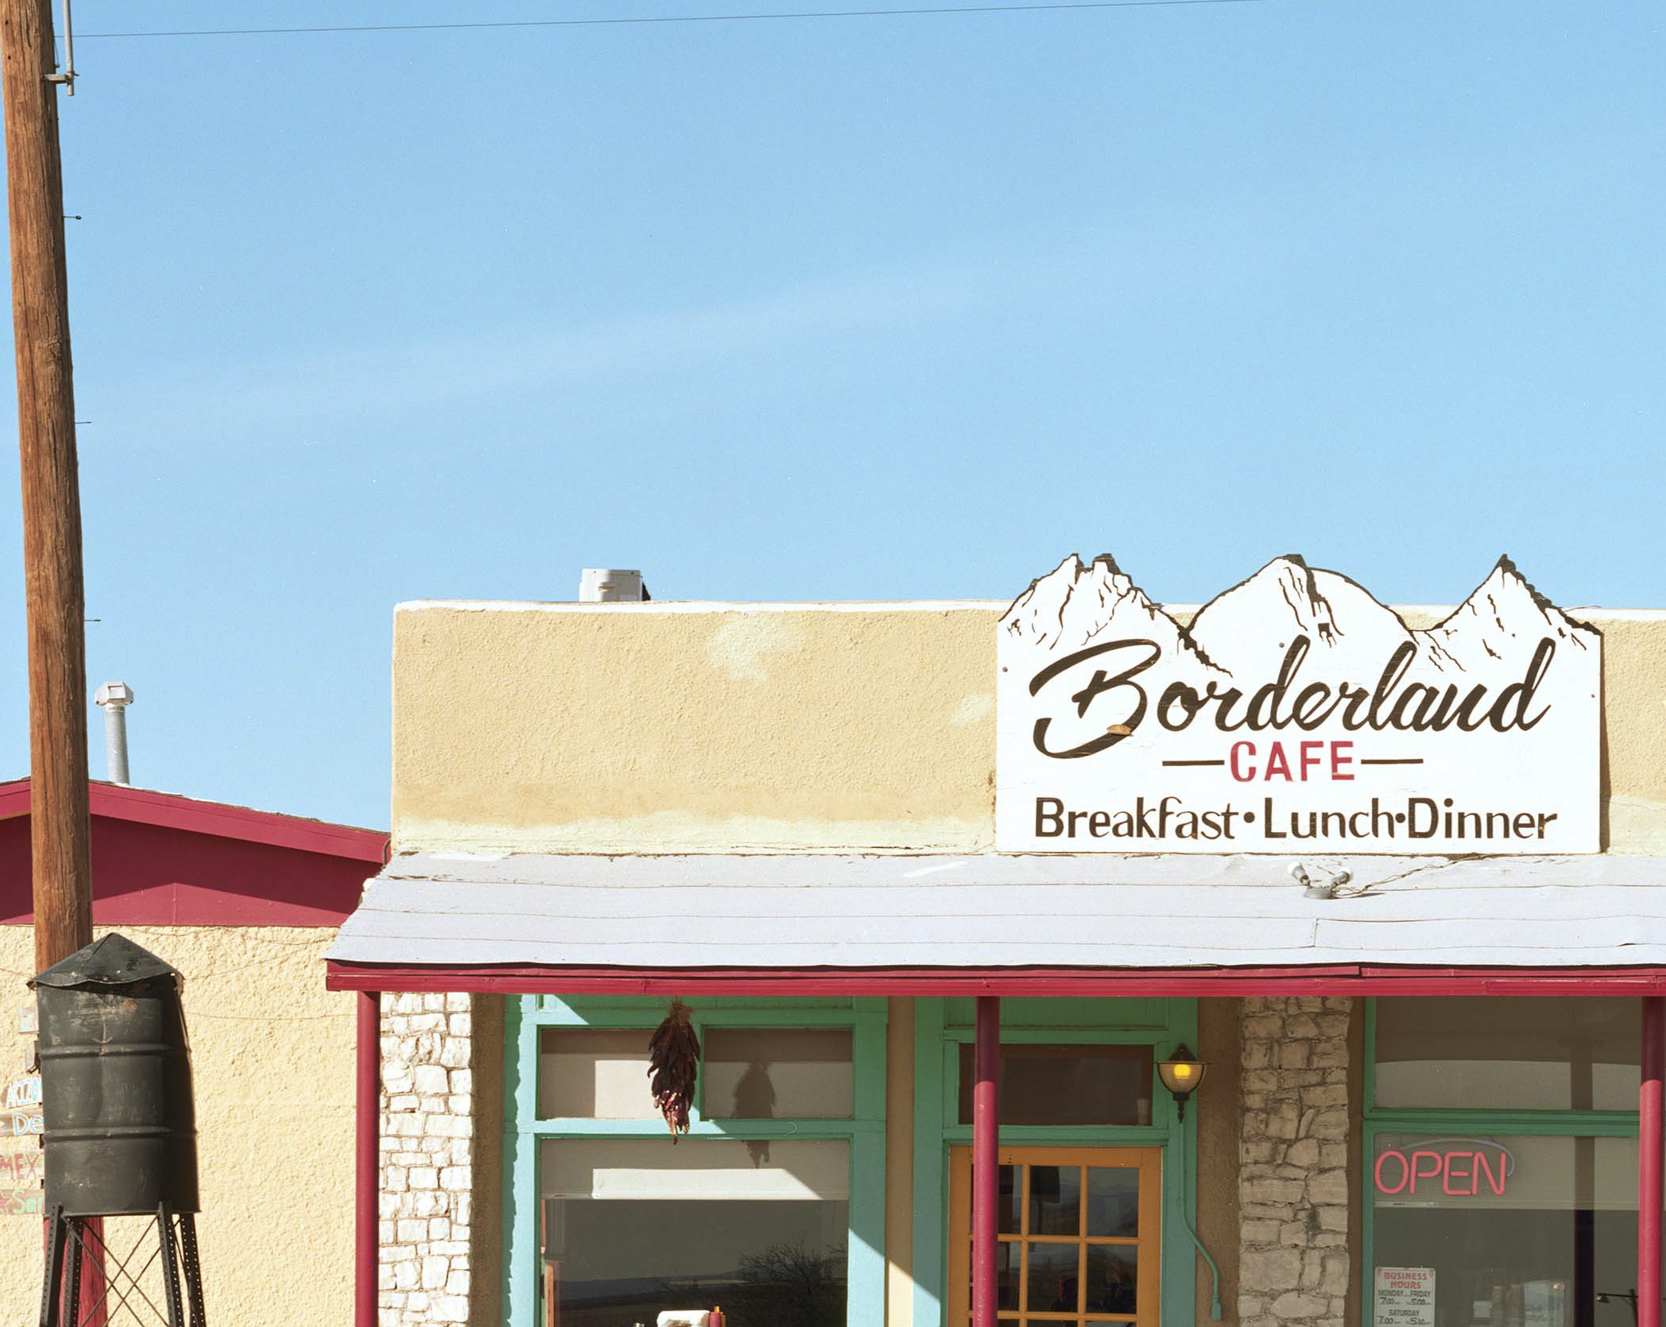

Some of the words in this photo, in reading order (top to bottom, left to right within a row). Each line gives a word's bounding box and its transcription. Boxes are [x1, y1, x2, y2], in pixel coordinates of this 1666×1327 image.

[1029, 634, 1559, 760] Borderland
[1229, 740, 1355, 783] CAFE
[1033, 796, 1240, 840] Breakfast
[1263, 797, 1398, 841] Lunch
[1407, 797, 1558, 840] Dinner
[13, 1113, 44, 1136] De
[1374, 1150, 1507, 1196] OPEN
[1384, 1272, 1427, 1281] BUSINESS
[1390, 1281, 1421, 1289] HOURS
